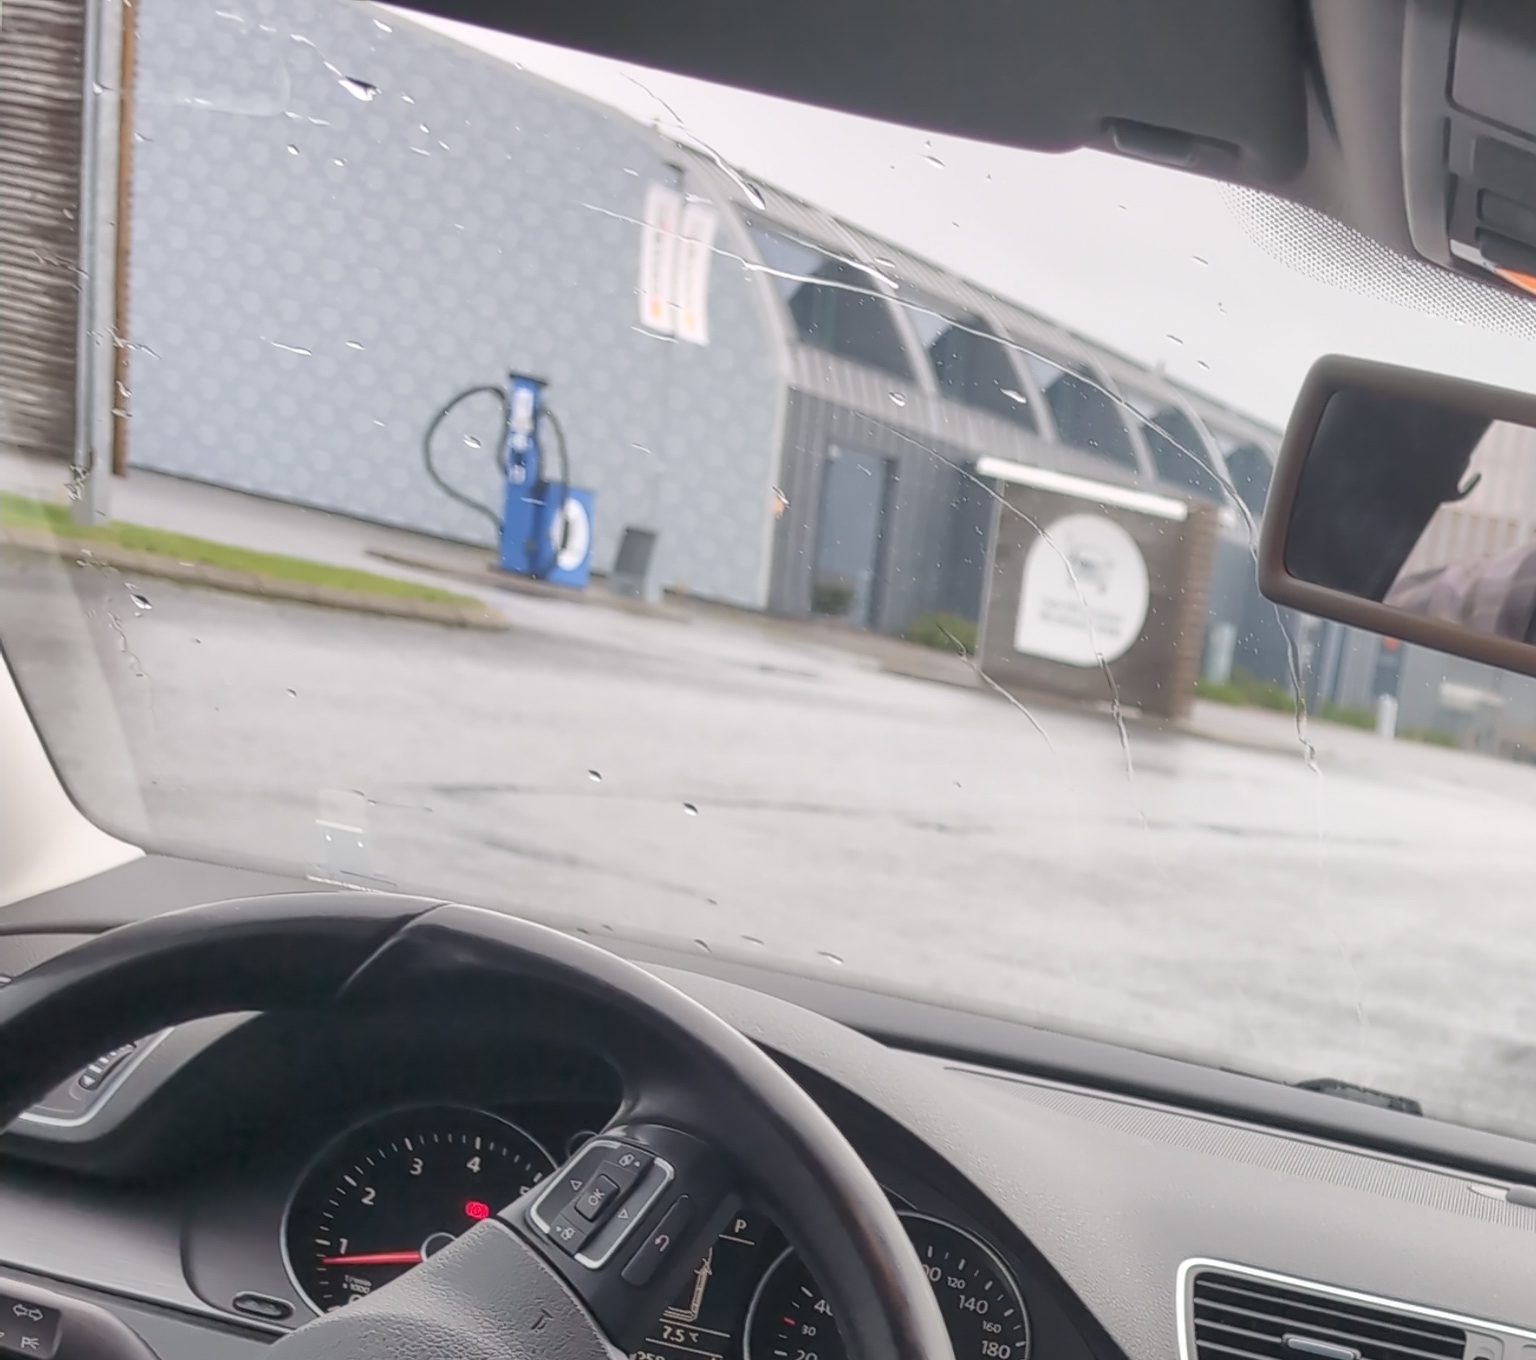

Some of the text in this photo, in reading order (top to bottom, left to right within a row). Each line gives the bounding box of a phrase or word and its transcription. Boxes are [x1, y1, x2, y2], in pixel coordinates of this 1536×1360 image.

[409, 1158, 424, 1176] 3
[467, 1157, 482, 1173] 4
[361, 1186, 376, 1205] 2
[588, 1188, 606, 1207] OK
[734, 1218, 747, 1233] P
[947, 1276, 966, 1290] 120
[959, 1294, 989, 1315] 140
[662, 1325, 686, 1343] 7.5
[801, 1324, 816, 1336] 30
[982, 1320, 1002, 1334] 160
[981, 1340, 1011, 1360] 180
